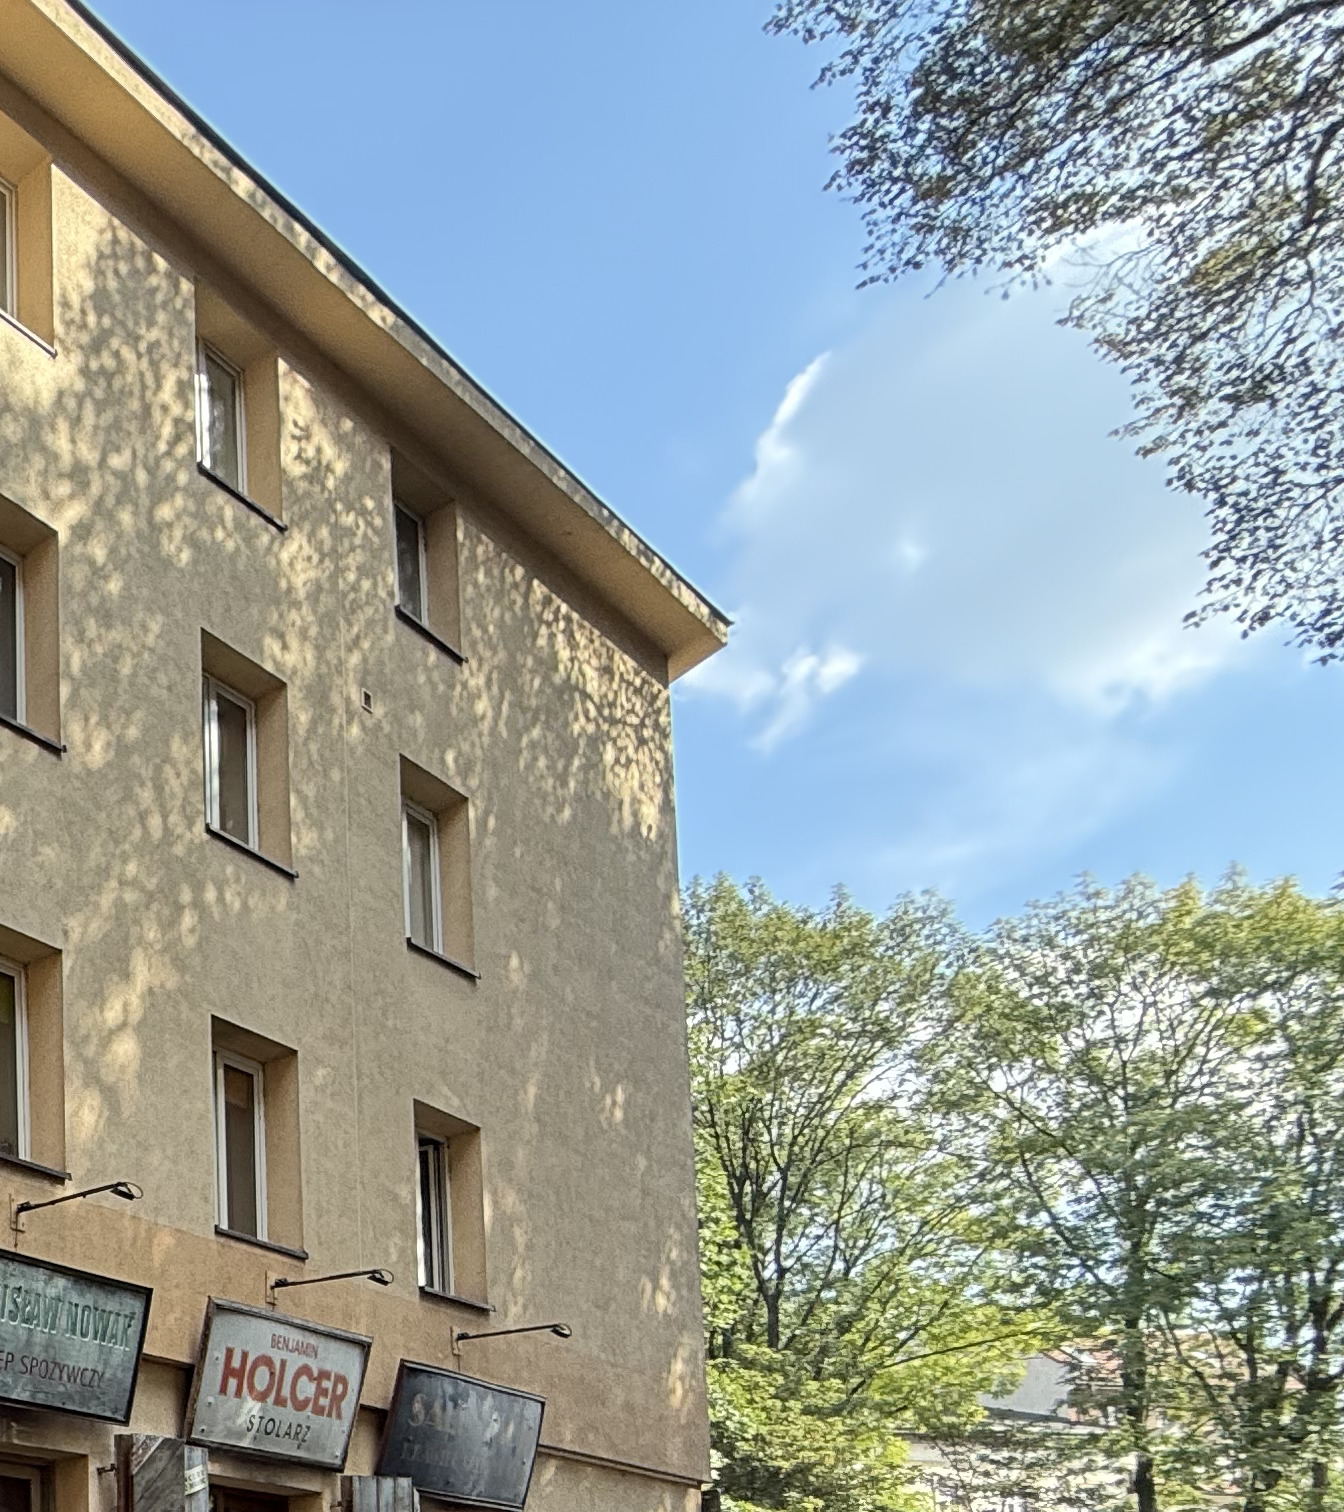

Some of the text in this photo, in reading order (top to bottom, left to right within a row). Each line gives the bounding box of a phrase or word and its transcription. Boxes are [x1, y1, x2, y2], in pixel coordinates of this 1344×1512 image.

[64, 1301, 138, 1352] NOWAK
[270, 1333, 319, 1360] BENJAMIN
[219, 1346, 350, 1421] HOLCER
[246, 1414, 312, 1443] STOLARZ
